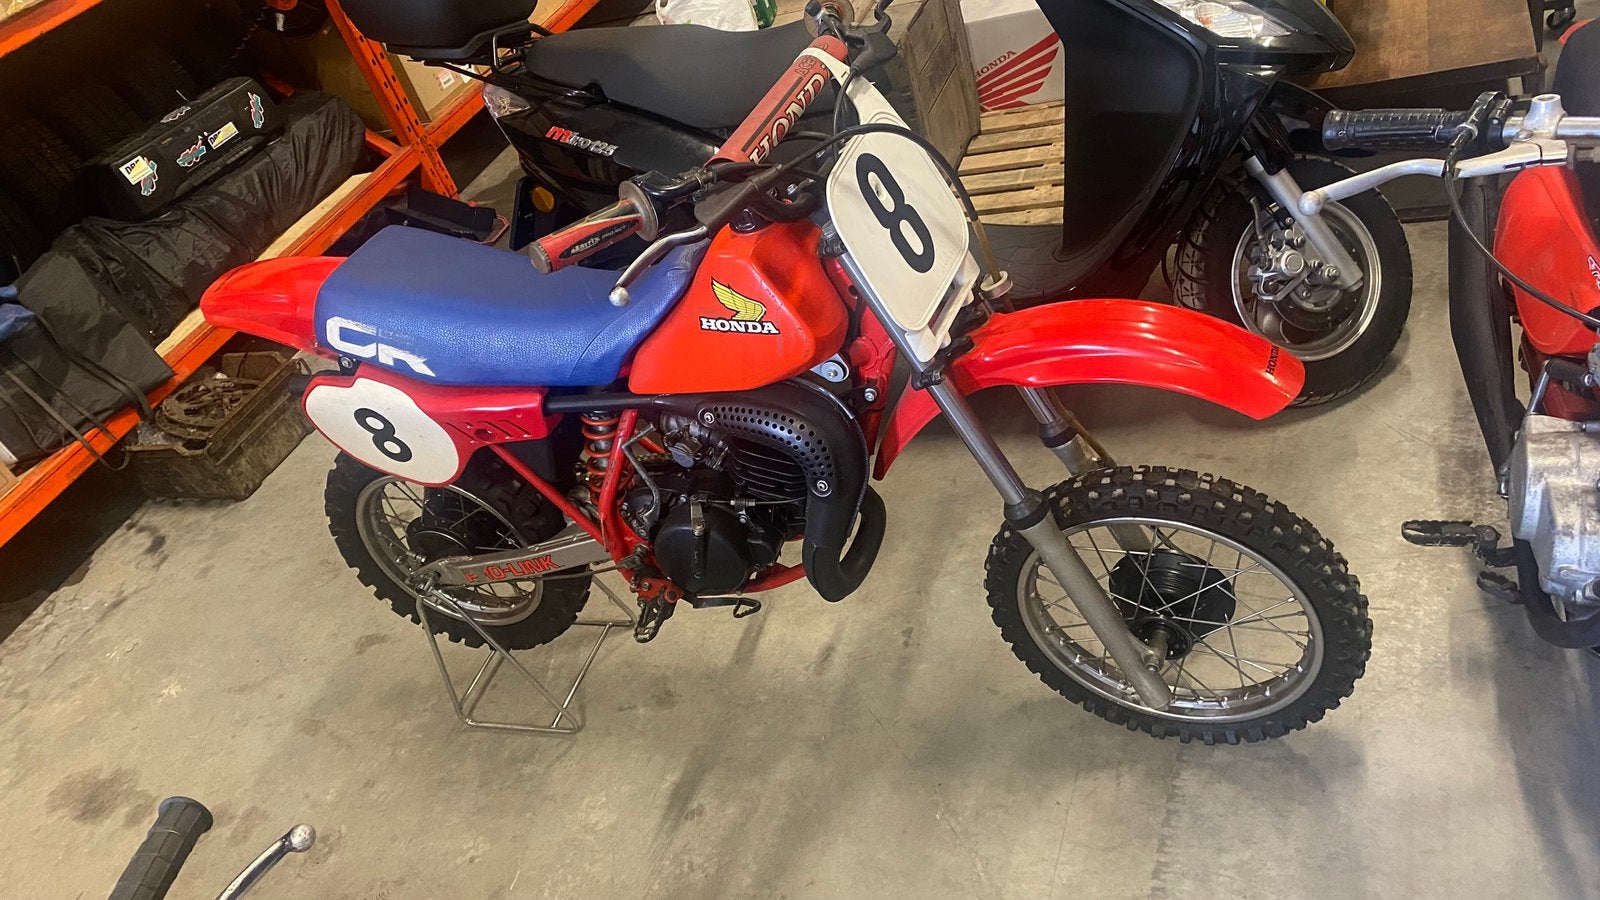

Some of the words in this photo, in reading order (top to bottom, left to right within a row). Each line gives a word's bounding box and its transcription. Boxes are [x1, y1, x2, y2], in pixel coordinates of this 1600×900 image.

[856, 153, 935, 274] 8
[699, 316, 781, 335] HONDA
[354, 408, 413, 463] 8
[464, 554, 562, 583] O-LINK
